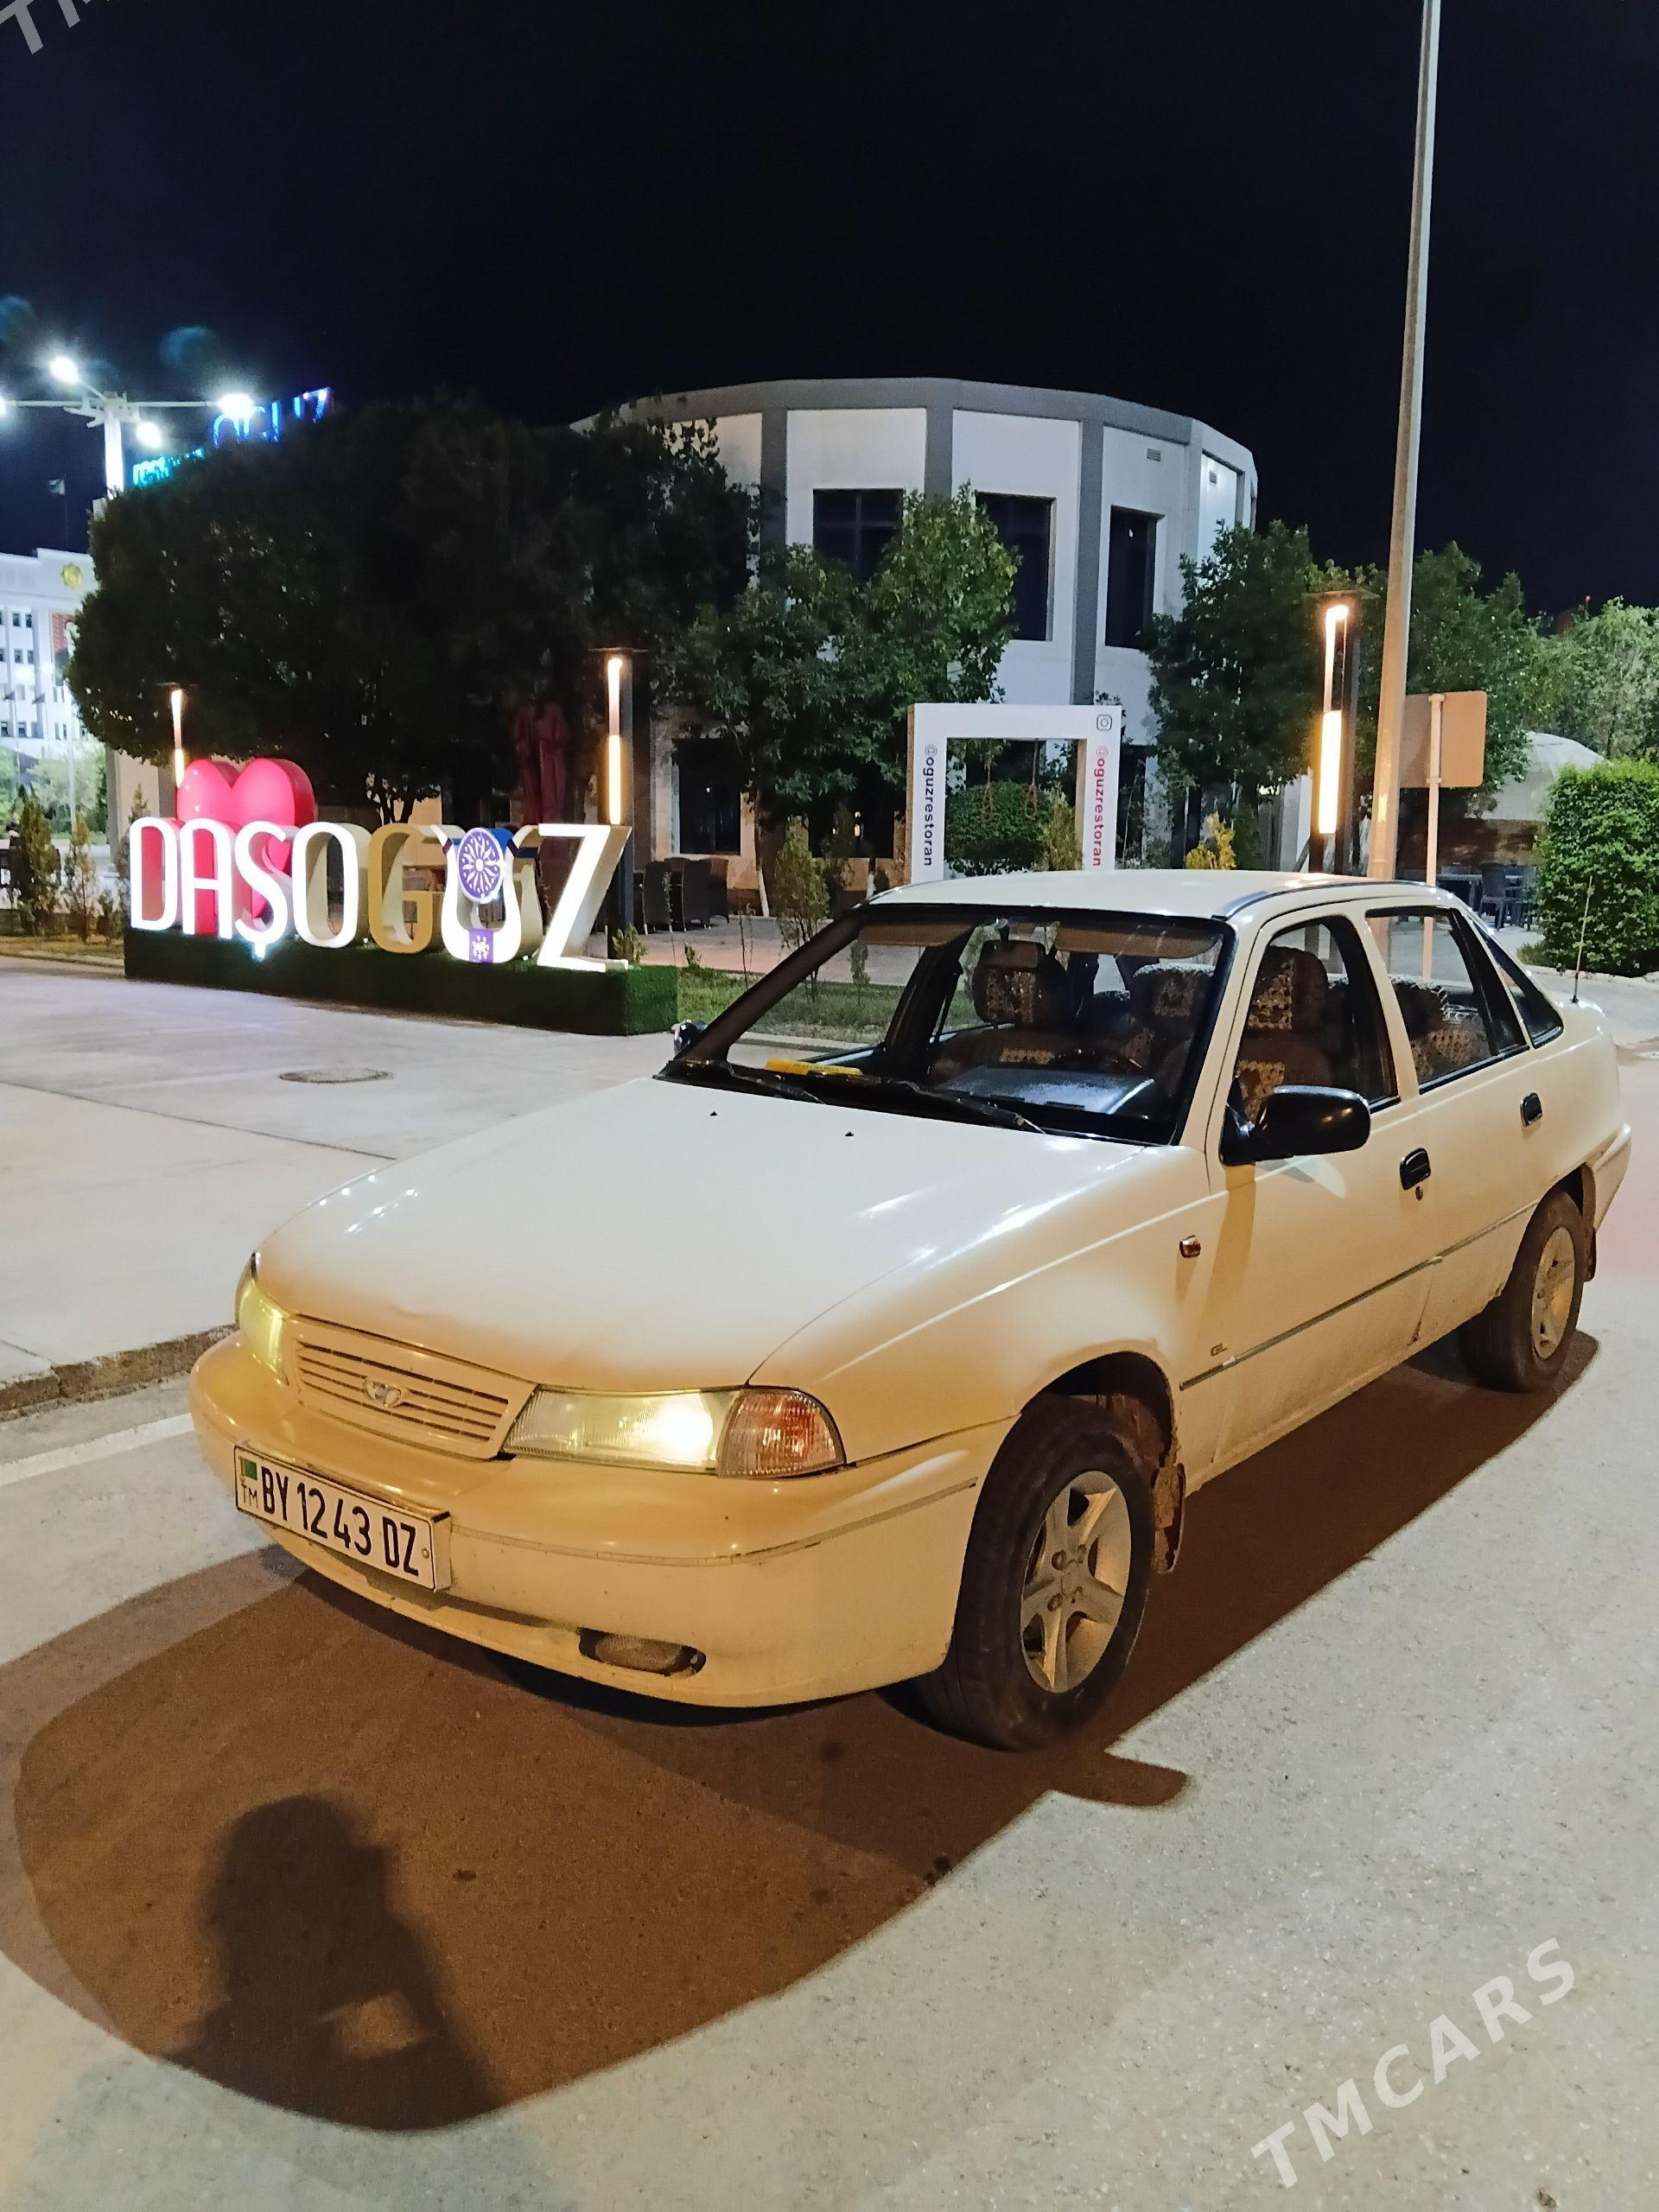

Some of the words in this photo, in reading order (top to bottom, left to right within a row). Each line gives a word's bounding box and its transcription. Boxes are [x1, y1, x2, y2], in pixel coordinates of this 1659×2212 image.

[923, 744, 938, 867] @oguzrestoran
[1092, 745, 1109, 868] @oguzrestoran
[1210, 1343, 1228, 1357] GL
[242, 1484, 258, 1509] TM
[261, 1465, 289, 1521] BY
[382, 1516, 419, 1577] DZ
